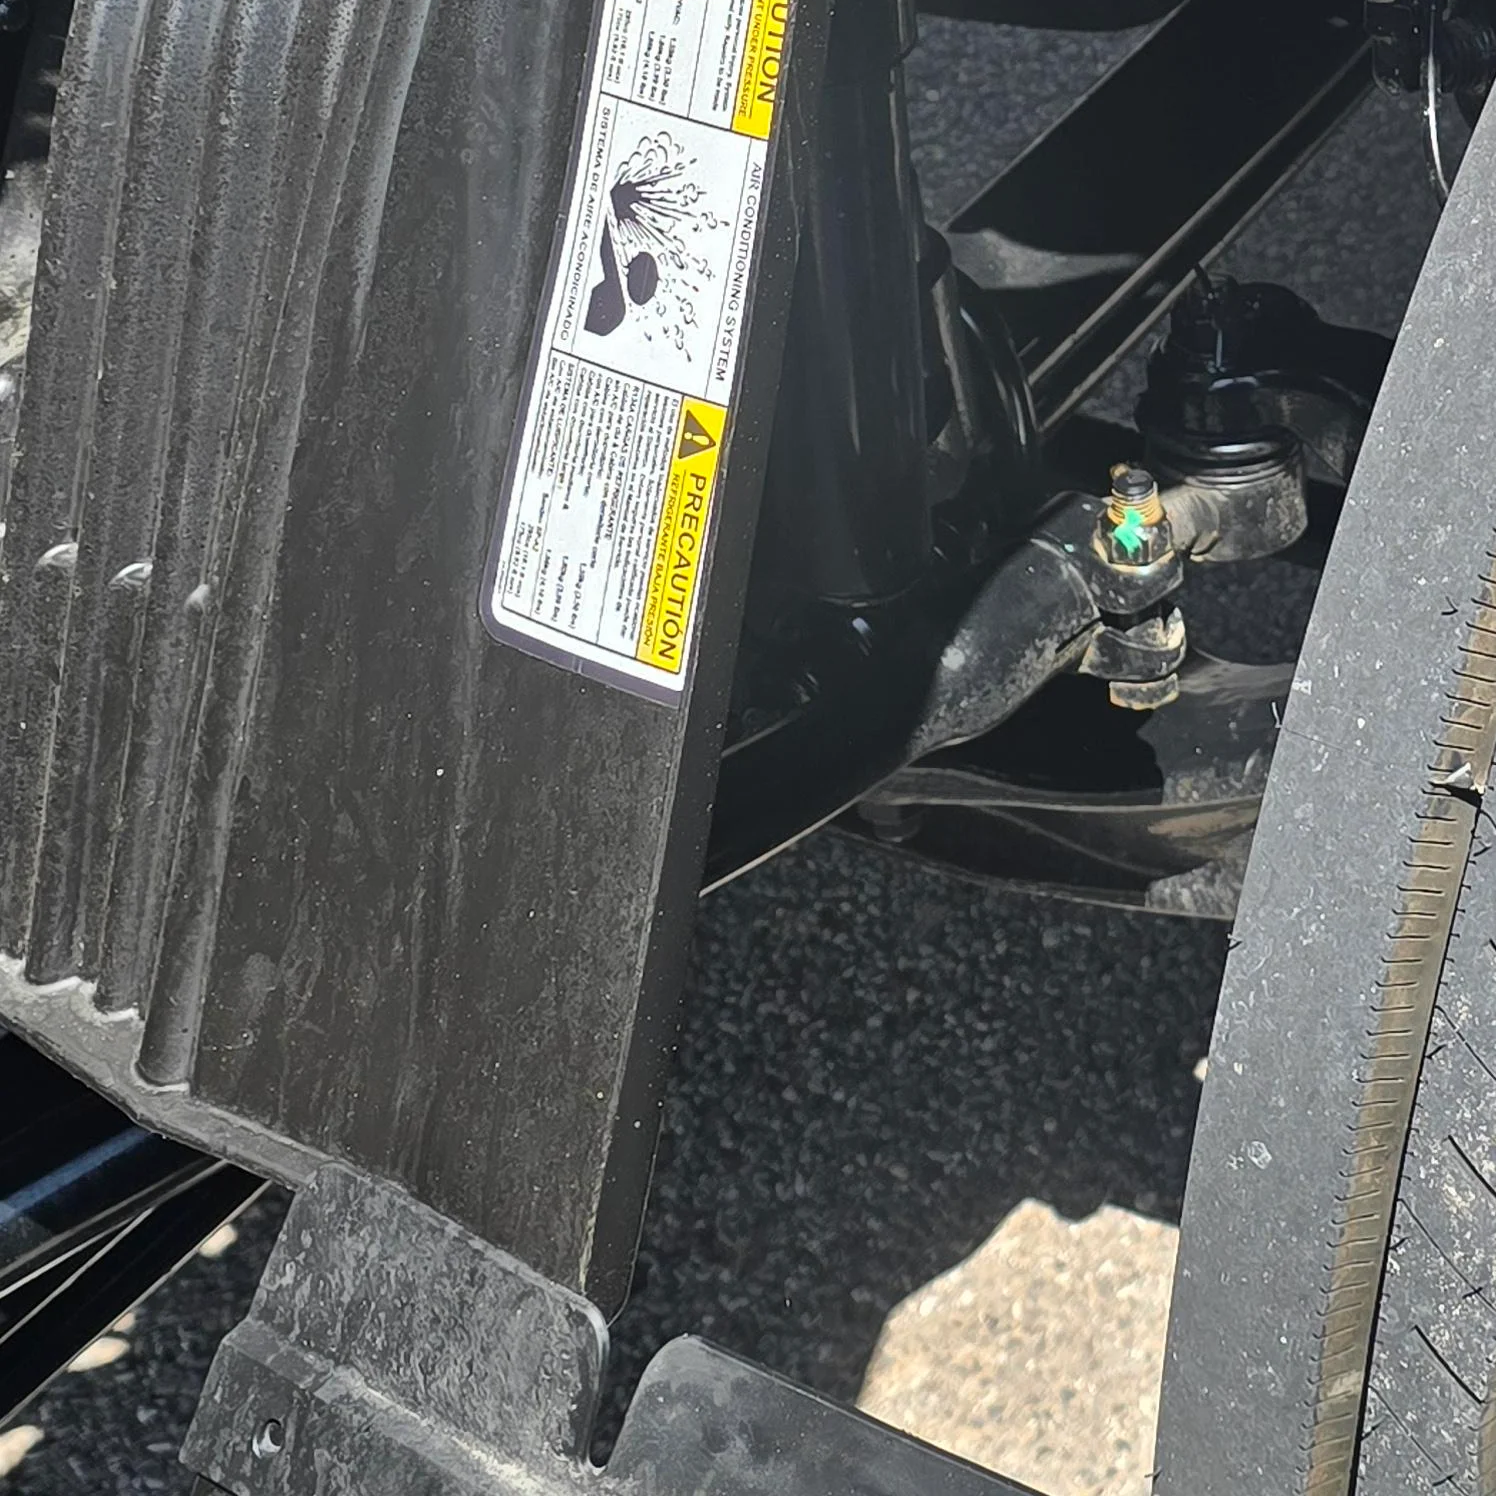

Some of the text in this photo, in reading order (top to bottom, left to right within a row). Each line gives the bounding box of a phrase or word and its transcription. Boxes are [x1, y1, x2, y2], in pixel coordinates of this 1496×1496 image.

[748, 13, 763, 54] UNDER
[738, 55, 756, 117] PRESSURE
[593, 106, 611, 169] SISTEMA
[583, 194, 596, 229] AIRE
[589, 172, 600, 192] DE
[715, 161, 763, 382] AIR CONDITIONING SYSTEM
[643, 472, 681, 647] REFRIGERANTE BAJA PRESIÓN
[658, 472, 707, 661] PRECAUTIÓN
